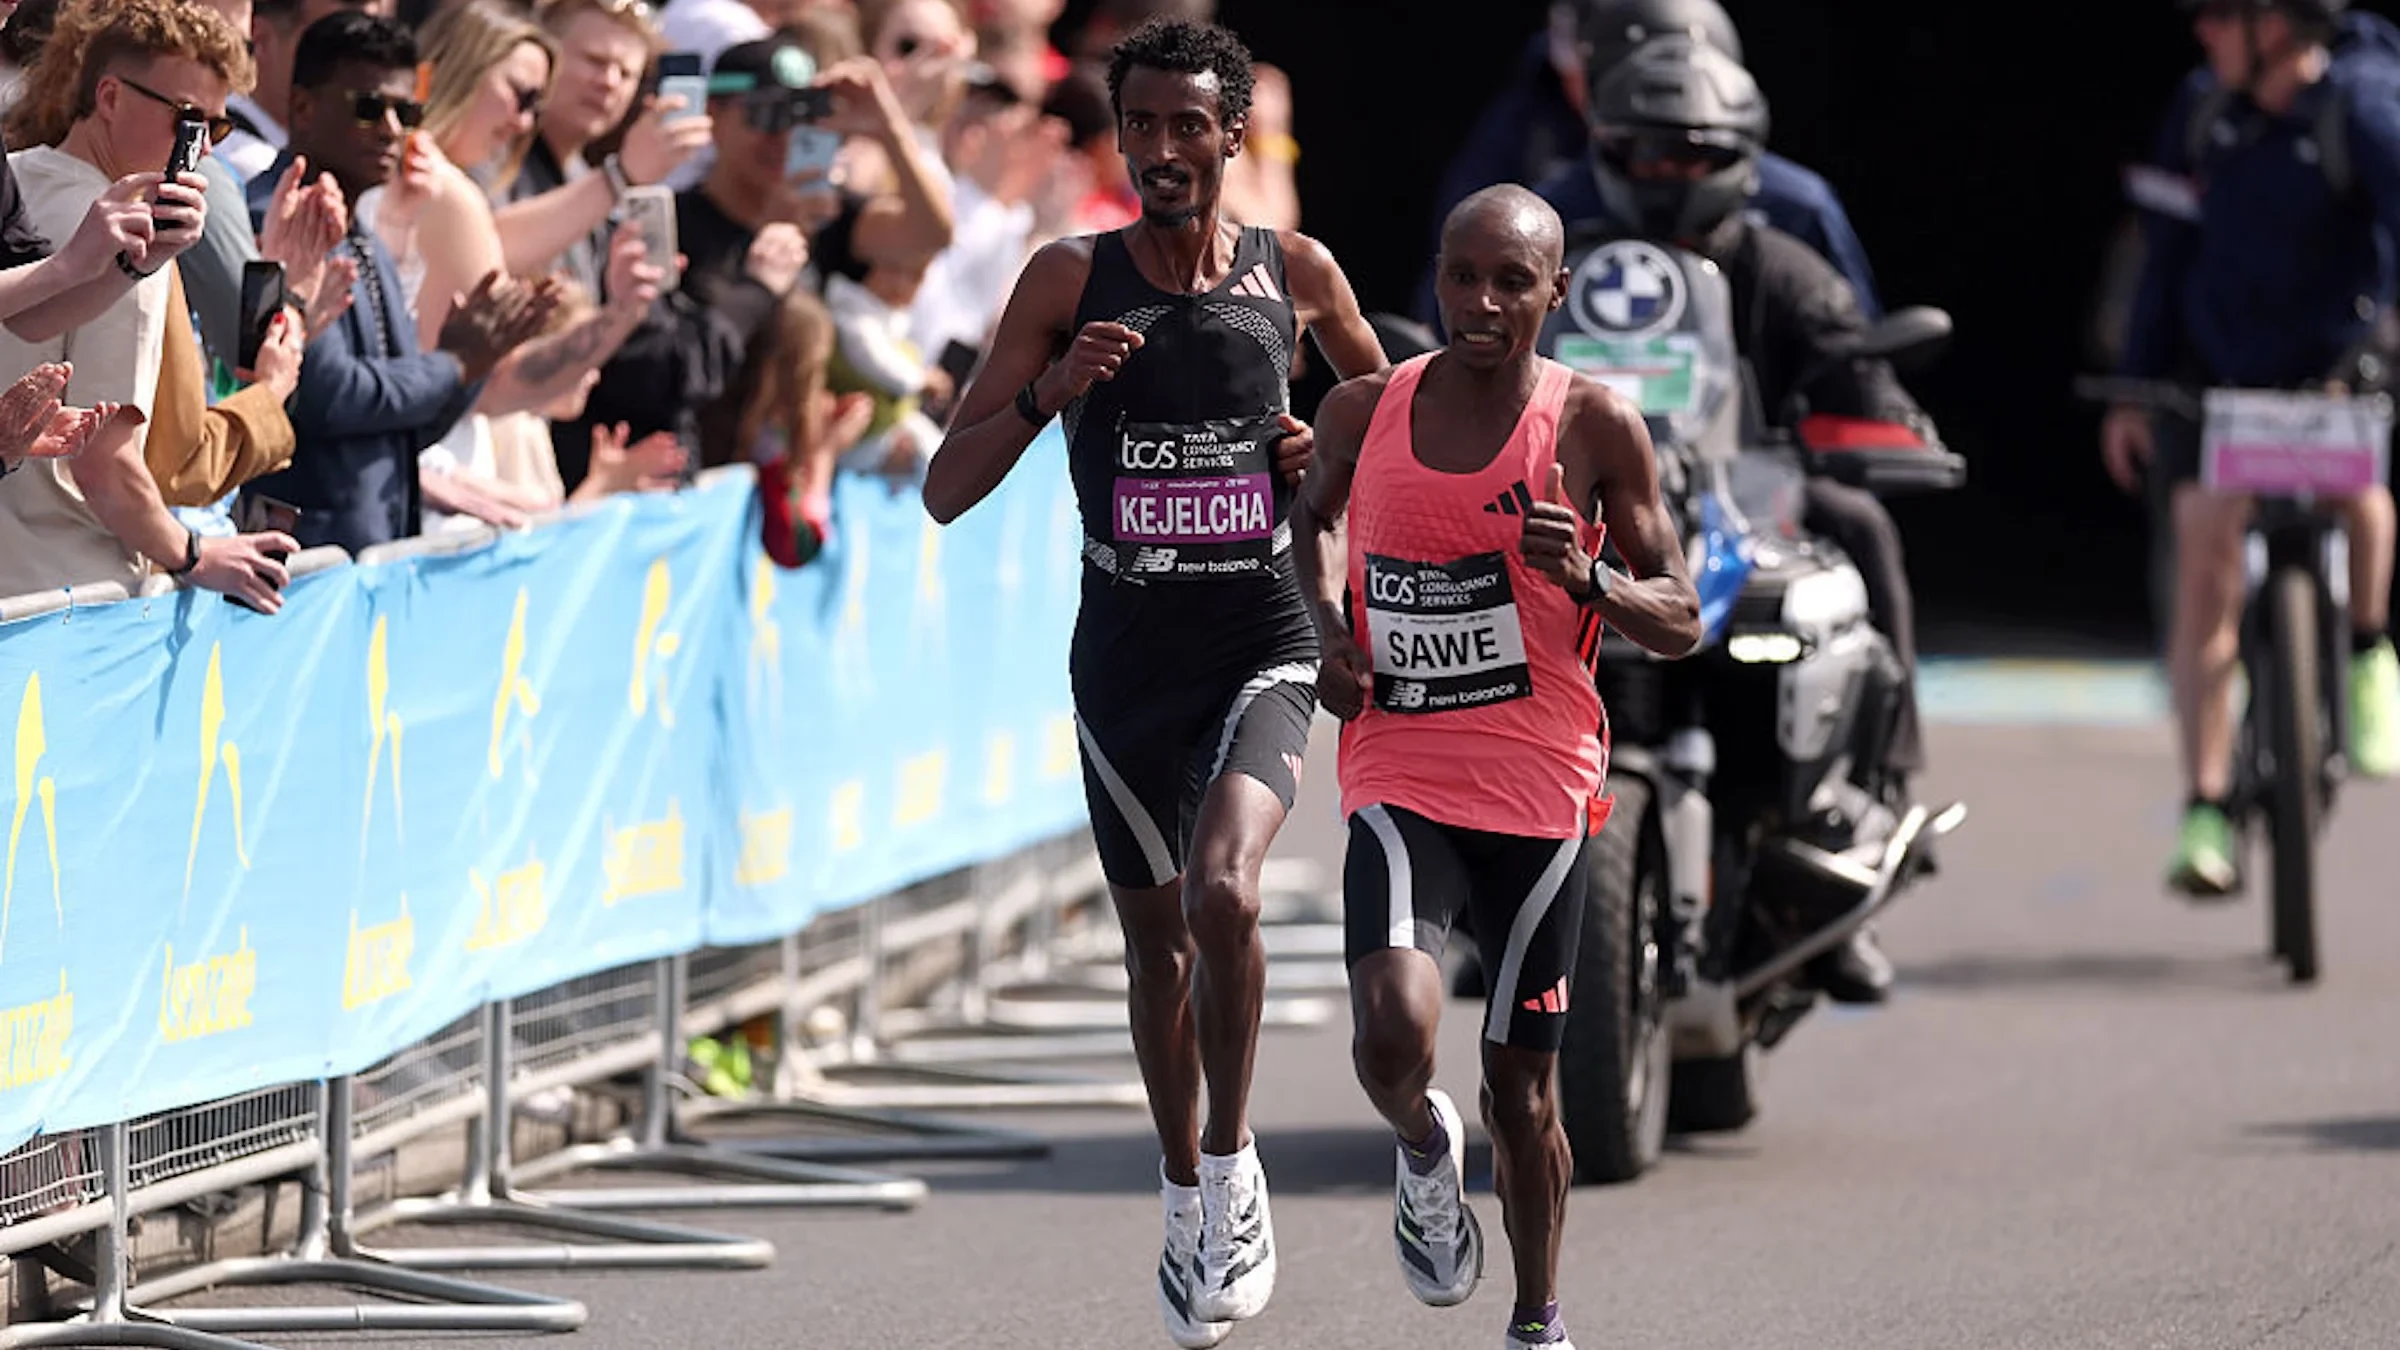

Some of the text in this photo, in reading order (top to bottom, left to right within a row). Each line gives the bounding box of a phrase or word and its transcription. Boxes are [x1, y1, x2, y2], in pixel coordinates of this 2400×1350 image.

[1122, 432, 1178, 469] tcs
[1183, 432, 1218, 443] TATA
[1119, 492, 1267, 535] KEJELCHA
[1370, 565, 1415, 605] tcs
[1388, 627, 1500, 670] SAWE
[1459, 682, 1517, 703] balance
